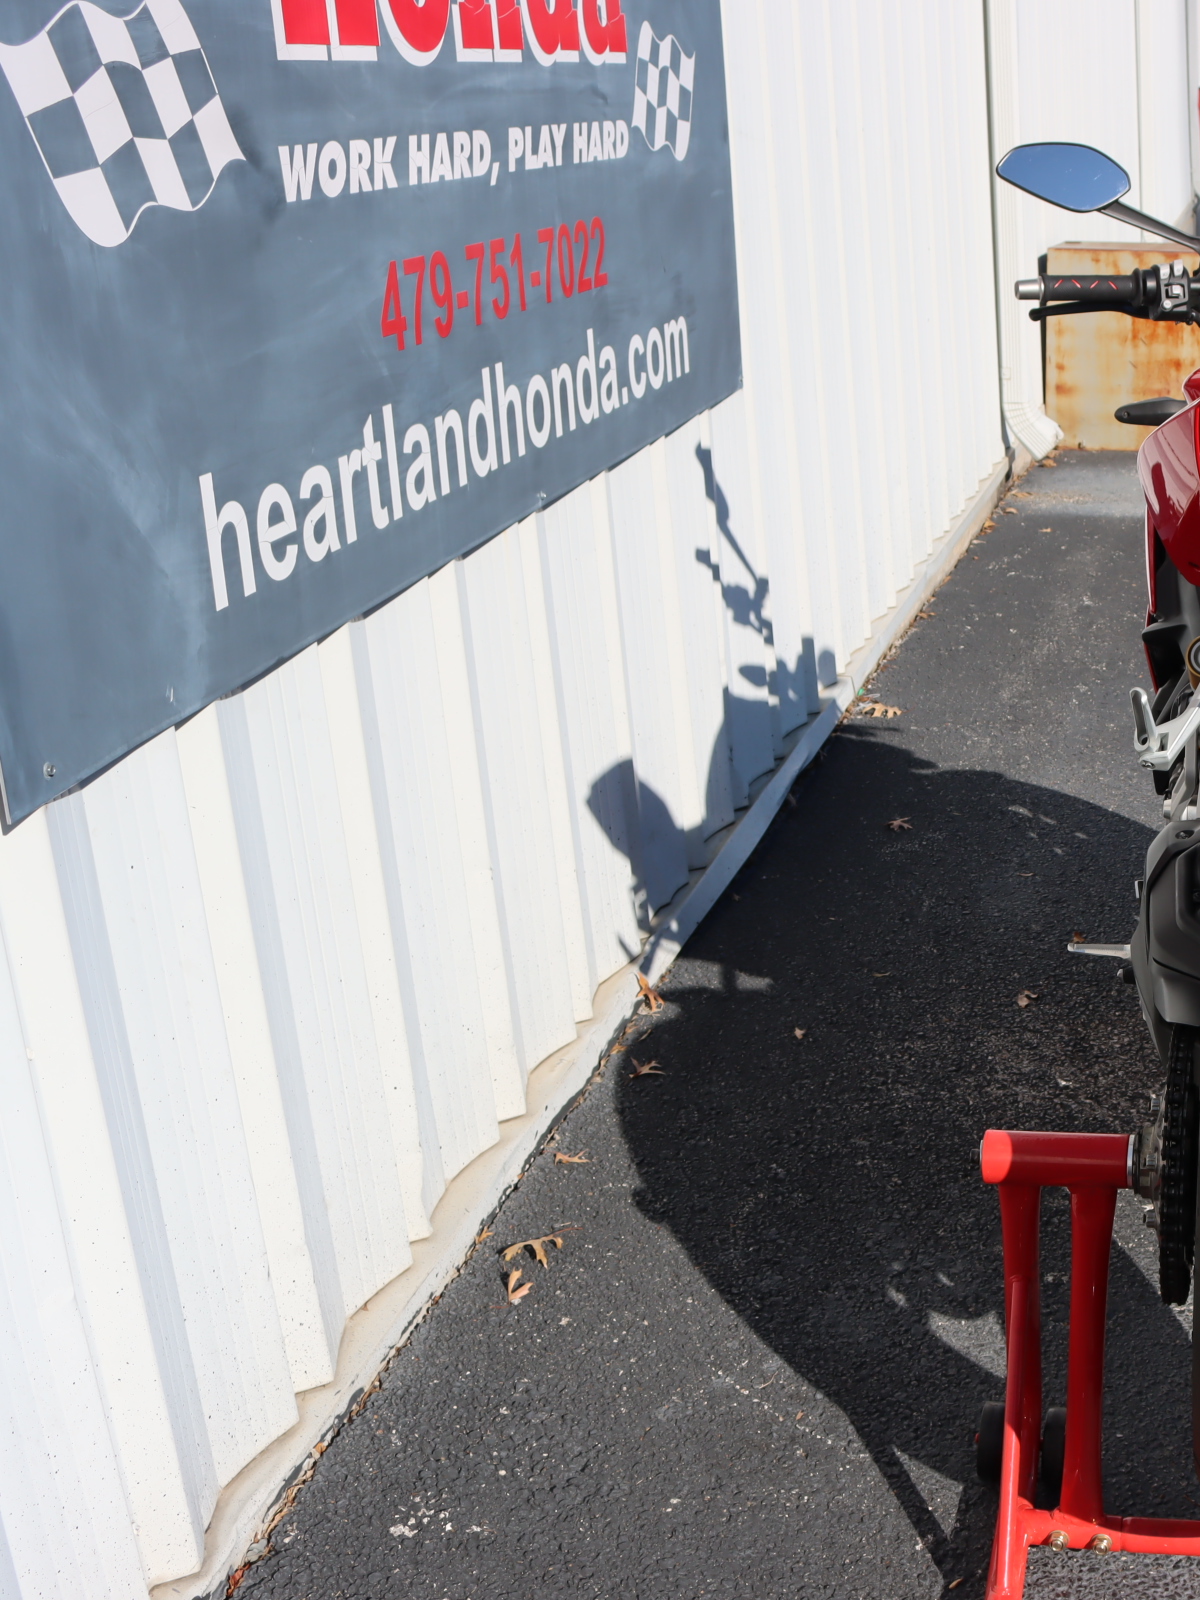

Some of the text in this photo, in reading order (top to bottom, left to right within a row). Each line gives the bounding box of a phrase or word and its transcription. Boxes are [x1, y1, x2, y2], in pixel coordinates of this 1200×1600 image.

[278, 119, 630, 203] WORK HARD, PLAY HARD
[380, 215, 609, 352] 479-751-7022
[199, 315, 691, 613] heartlandhonda.com
